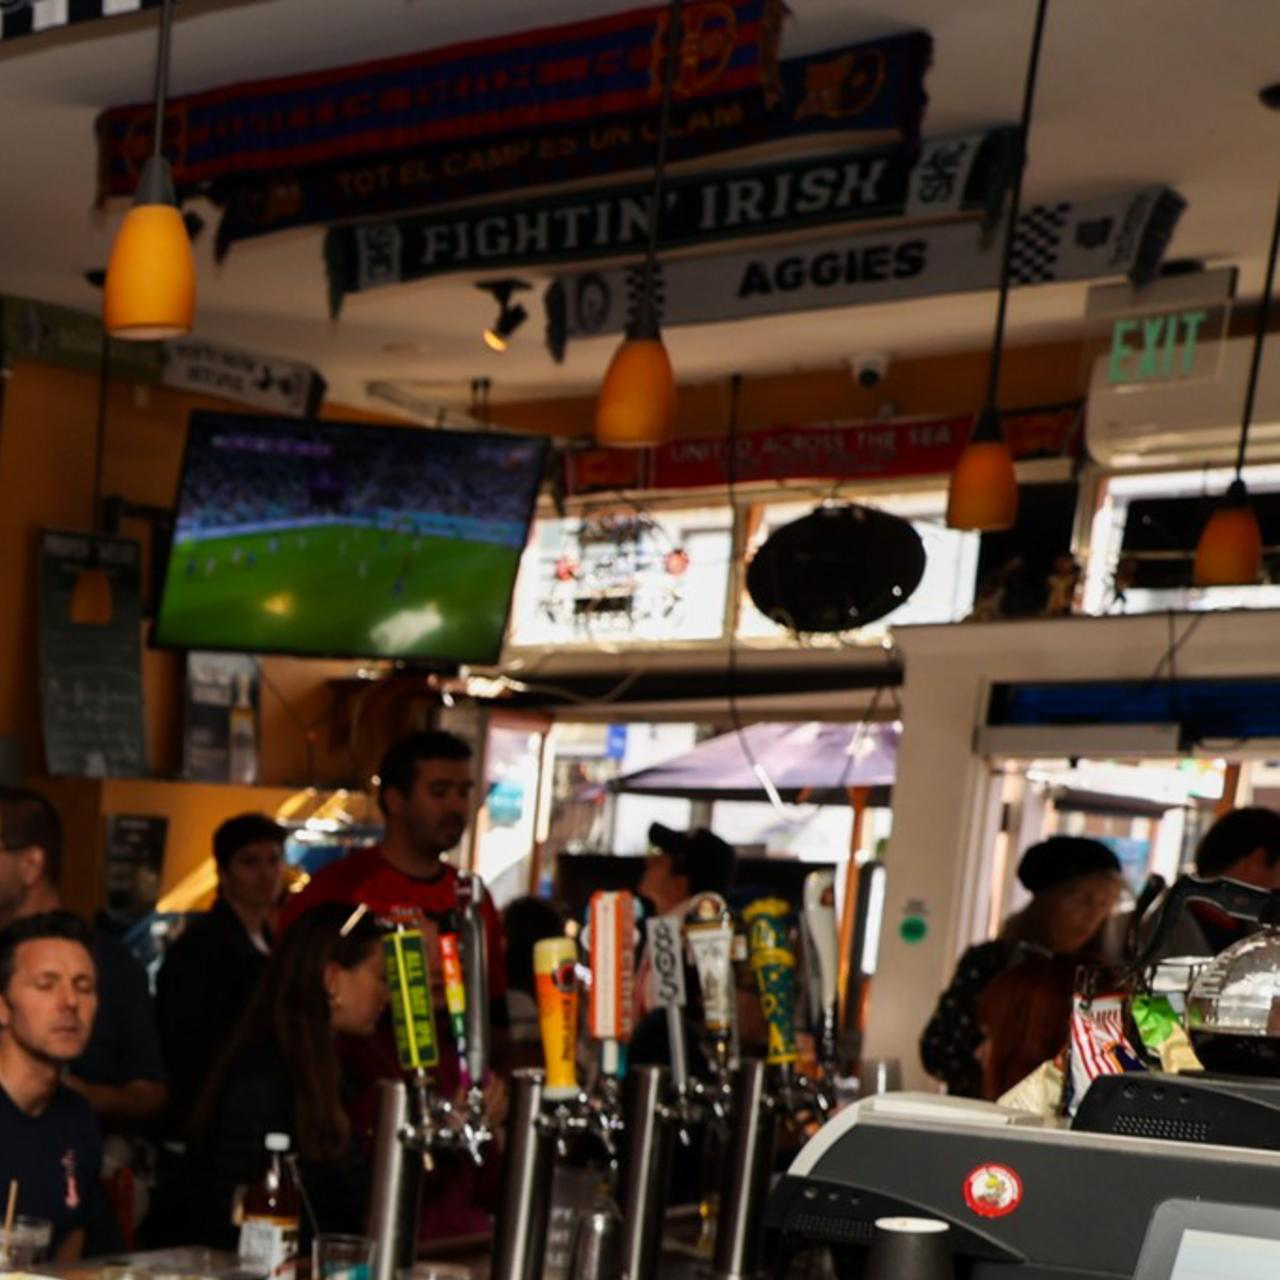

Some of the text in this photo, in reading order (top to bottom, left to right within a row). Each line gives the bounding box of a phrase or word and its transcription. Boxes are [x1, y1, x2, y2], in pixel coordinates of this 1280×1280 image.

[422, 158, 887, 265] FIGHTIN' IRISH
[739, 240, 928, 297] AGGIES
[1108, 309, 1207, 383] EXIT
